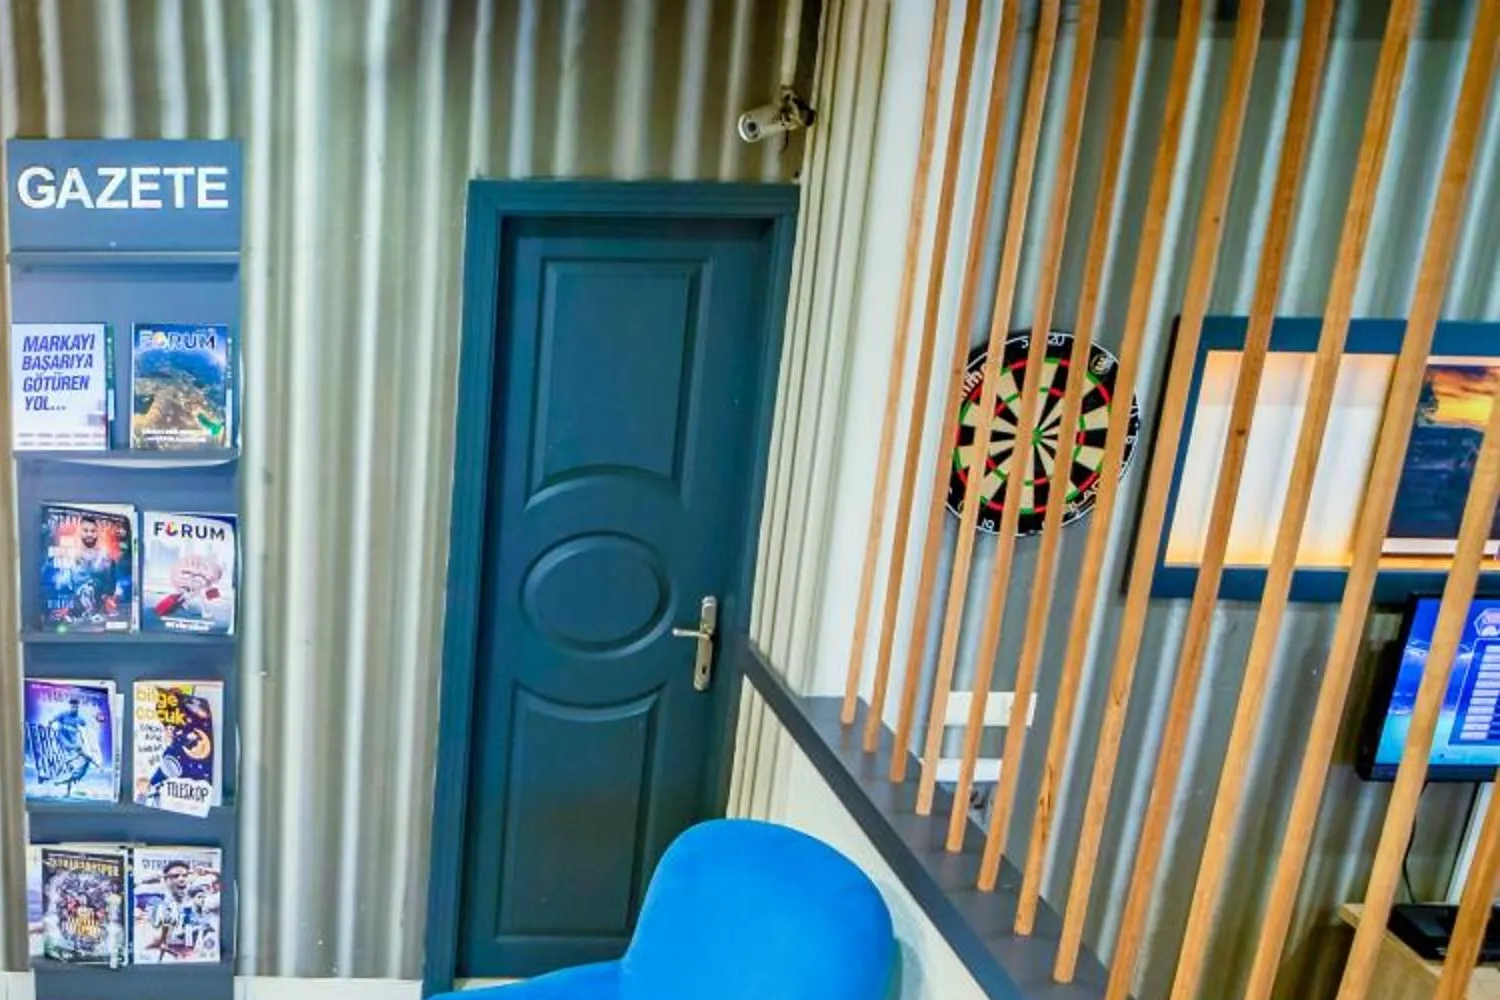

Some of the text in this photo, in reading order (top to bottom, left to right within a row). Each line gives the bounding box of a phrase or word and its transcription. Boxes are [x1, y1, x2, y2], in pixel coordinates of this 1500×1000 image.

[17, 166, 229, 209] GAZETE
[22, 334, 95, 352] MARKAYI
[139, 330, 216, 350] FORUM
[21, 353, 94, 372] BAŞARIYA
[23, 371, 90, 392] GÖTÜREN
[153, 521, 225, 541] FORUM
